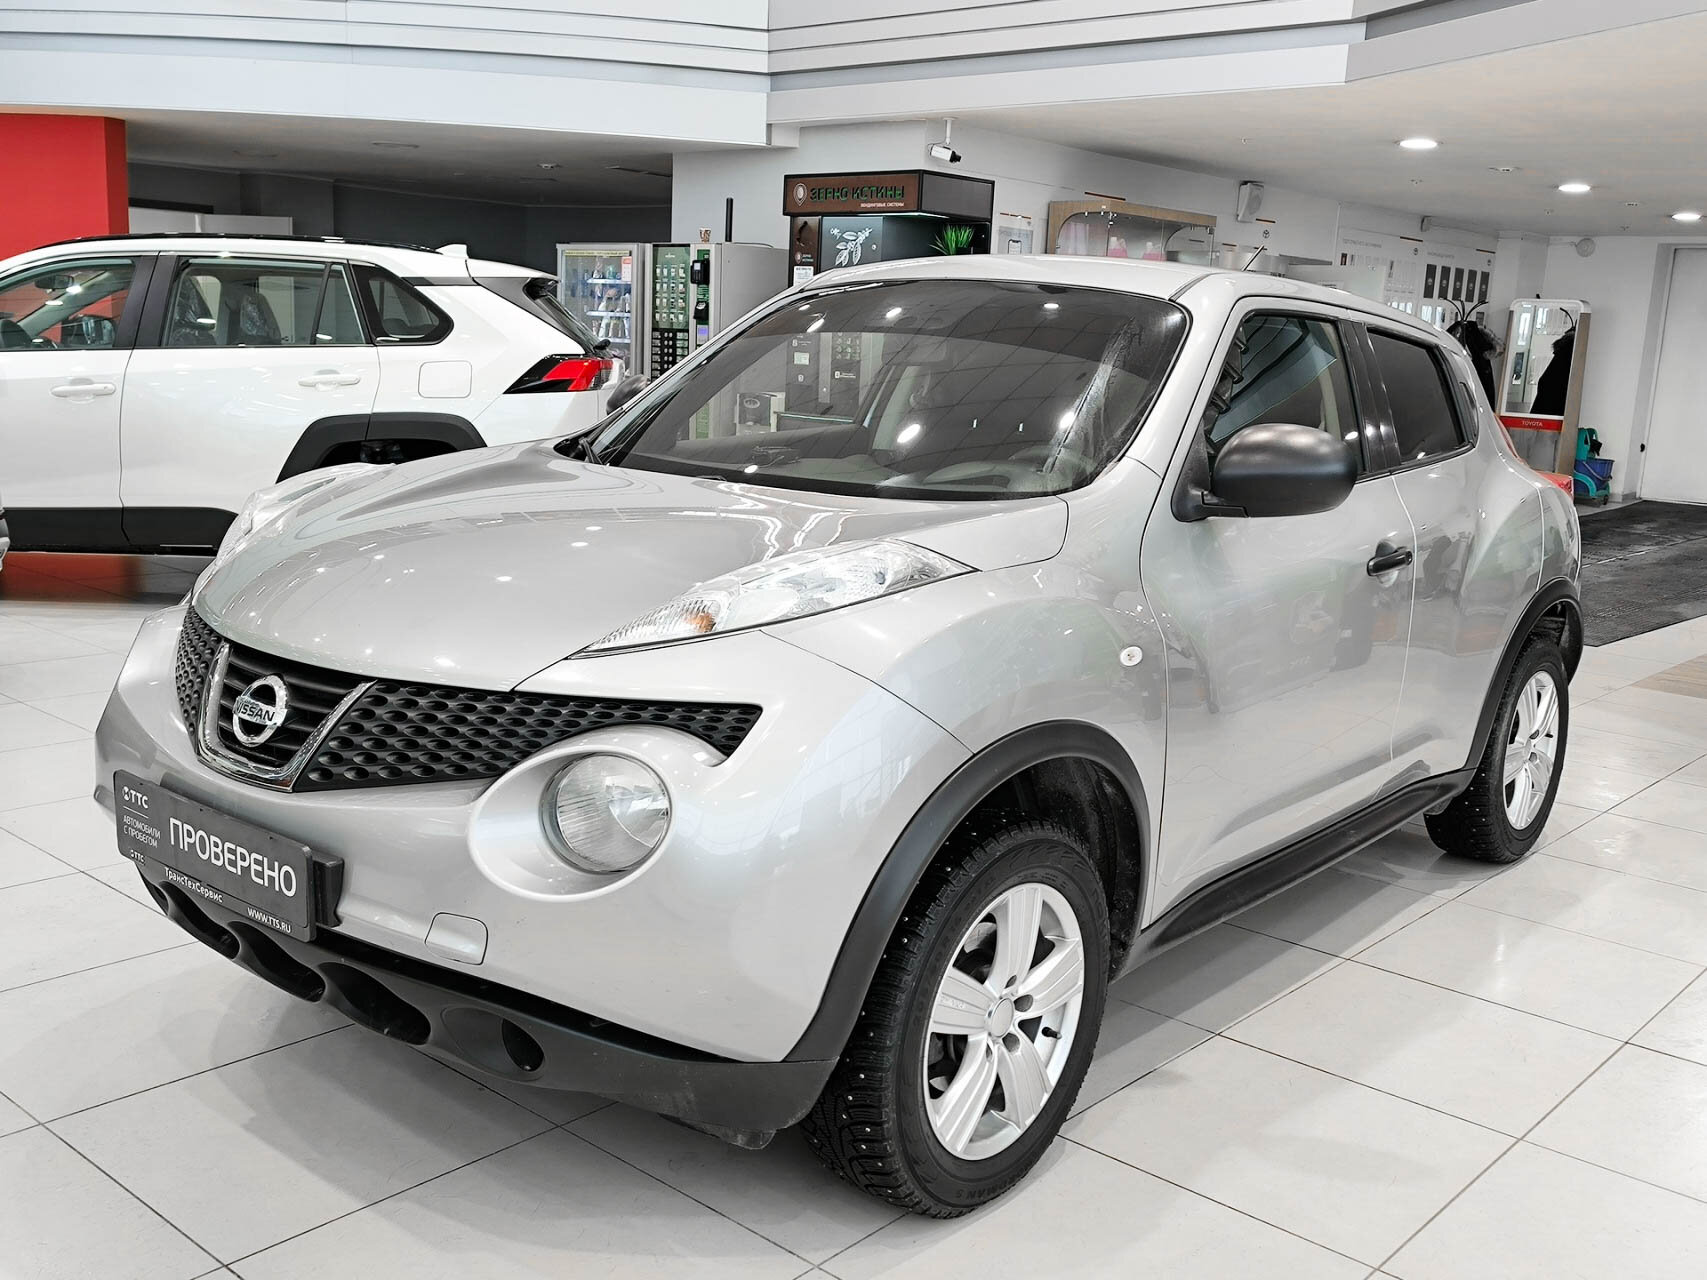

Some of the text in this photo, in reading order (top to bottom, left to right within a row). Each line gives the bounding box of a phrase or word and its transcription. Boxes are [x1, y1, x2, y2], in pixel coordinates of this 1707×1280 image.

[810, 185, 905, 201] ЗЕРНО ИСТИНЫ
[236, 701, 275, 721] NISSAN
[123, 815, 160, 840] АВТОМОБИЛИ
[128, 827, 158, 848] ПРОБЕГОМ
[169, 817, 297, 897] ПРОВЕРЕНО
[164, 867, 224, 903] ТрансТехСервис
[247, 907, 292, 934] WWW.TTS.RU
